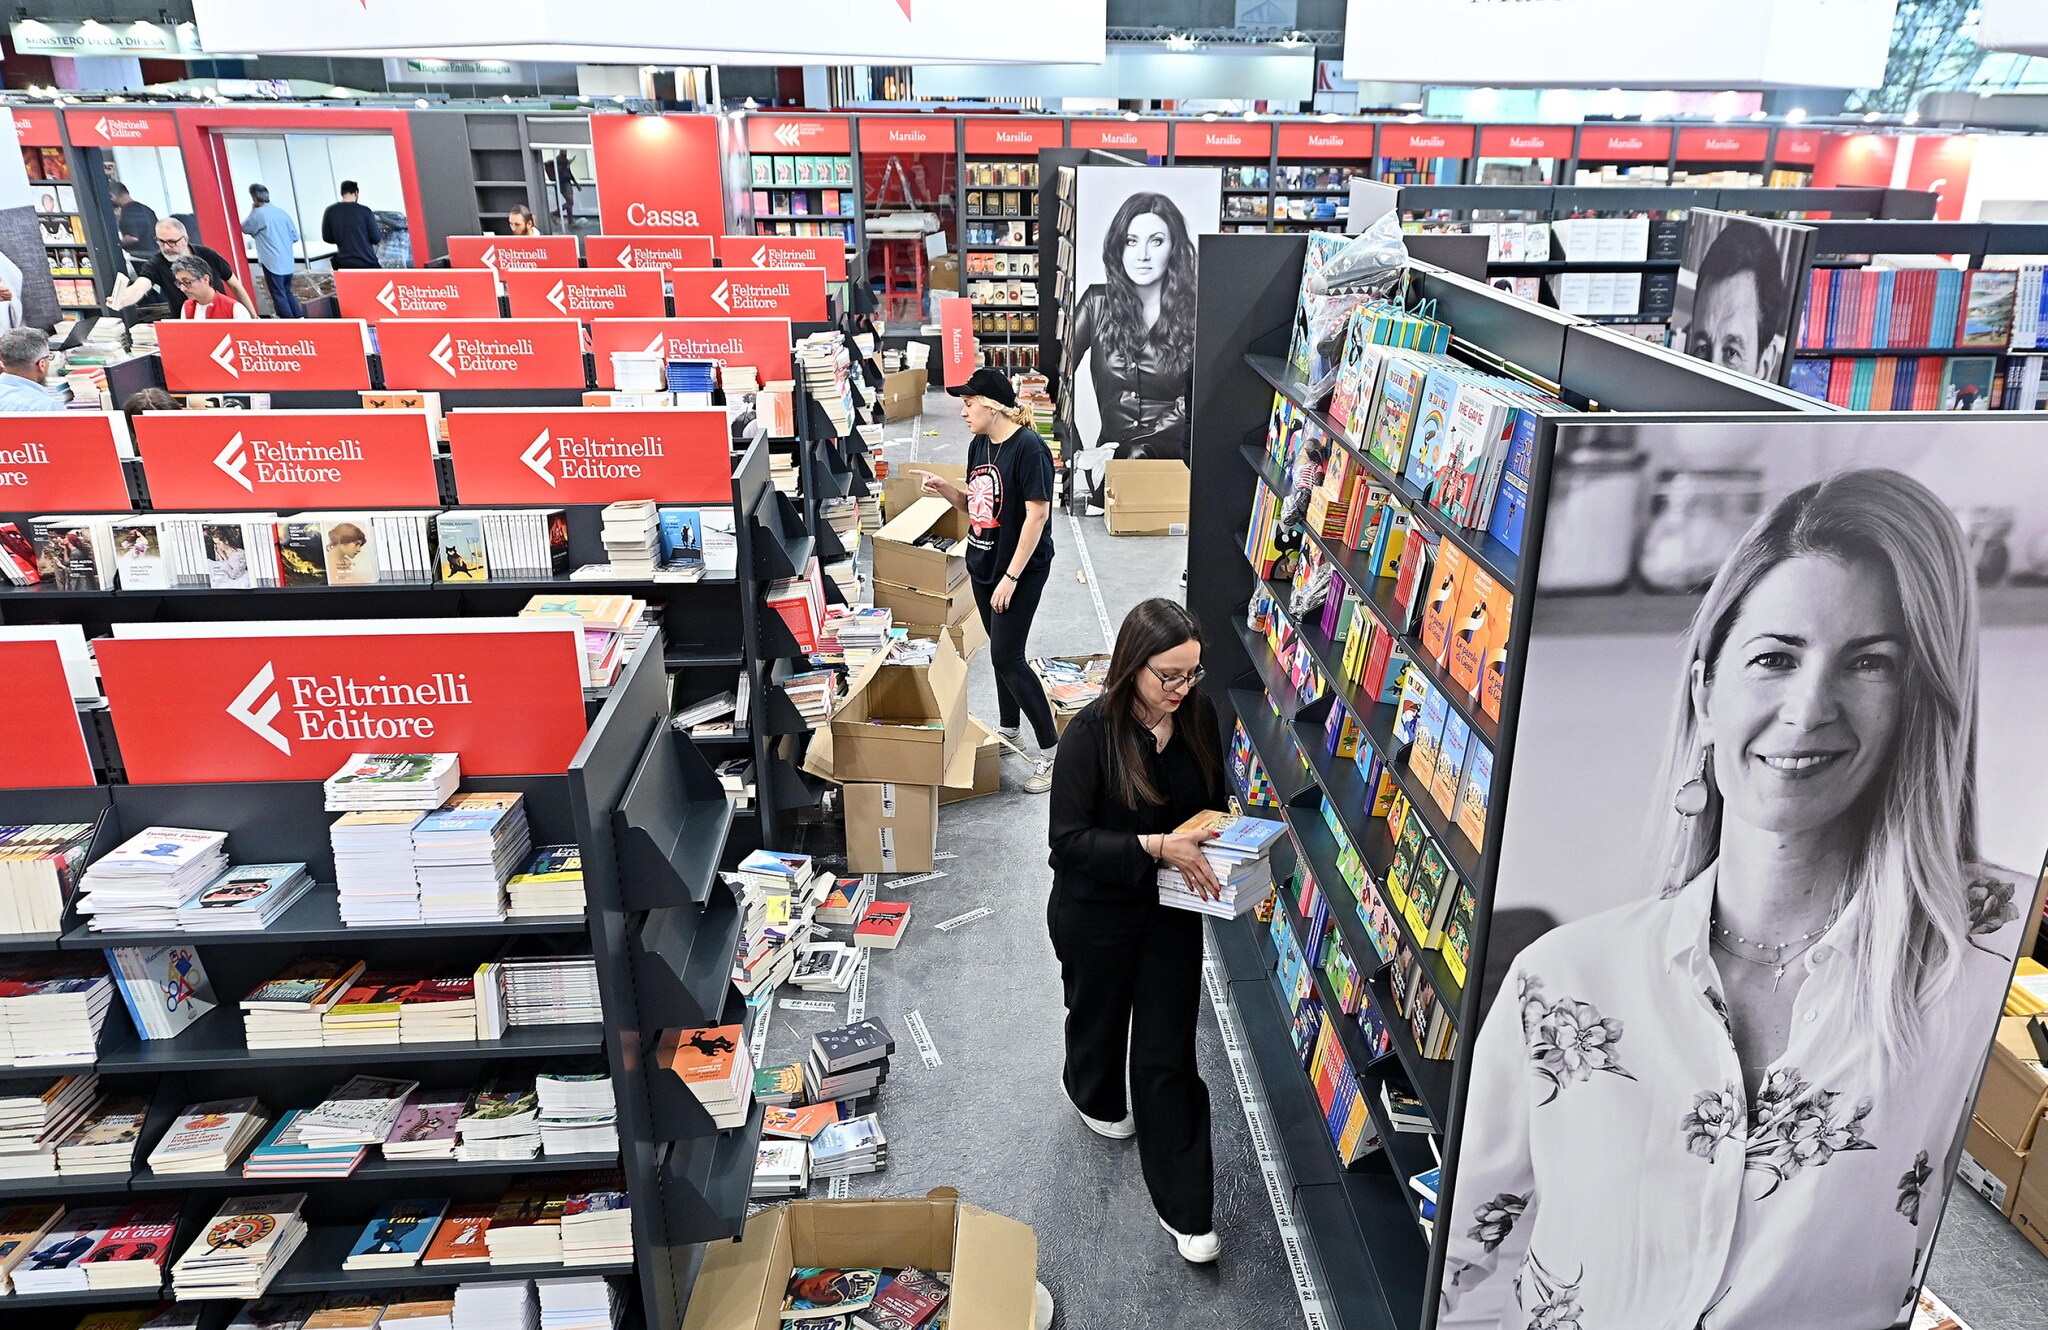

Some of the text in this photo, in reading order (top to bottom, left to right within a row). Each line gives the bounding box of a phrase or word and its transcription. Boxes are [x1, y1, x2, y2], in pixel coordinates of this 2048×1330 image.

[108, 119, 150, 130] Feltrinelli
[110, 128, 141, 138] Editore
[889, 129, 927, 142] Marsilio
[996, 131, 1033, 143] Marsilio
[1101, 132, 1138, 145] Marsilio
[1205, 134, 1241, 146] Marsilio
[1308, 135, 1344, 147] Marsilio
[1409, 136, 1445, 148] Marsilio
[1509, 137, 1545, 149] Marsilio
[1608, 137, 1643, 150] Marsilio
[1705, 138, 1740, 151] Marsilio
[627, 203, 699, 227] Cassa
[497, 248, 548, 260] Feltrinelli
[633, 248, 683, 260] Feltrinelli
[768, 248, 816, 260] Feltrinelli
[500, 259, 537, 269] Editore
[635, 259, 673, 269] Editore
[769, 259, 805, 268] Editore
[397, 284, 459, 299] Feltrinelli
[567, 284, 628, 298] Feltrinelli
[731, 283, 790, 296] Feltrinelli
[400, 298, 447, 311] Editore
[568, 297, 615, 310] Editore
[732, 296, 778, 309] Editore
[236, 340, 317, 356] Feltrinelli
[456, 339, 534, 355] Feltrinelli
[668, 338, 744, 354] Feltrinelli
[953, 327, 961, 364] Marsilio
[240, 356, 301, 372] Editore
[459, 355, 518, 371] Editore
[1457, 401, 1468, 417] THE
[1467, 409, 1485, 426] GAME
[250, 439, 364, 462] Feltrinelli
[556, 436, 665, 458] Feltrinelli
[255, 463, 341, 484] Editore
[560, 459, 642, 479] Editore
[1455, 637, 1462, 649] Le
[286, 673, 472, 708] Feltrinelli
[294, 710, 435, 741] Editore
[1233, 1057, 1250, 1095] ALLESTIMENTI
[1249, 1111, 1270, 1161] PP ALLESTIMENTI
[1266, 1170, 1290, 1227] PP ALLESTIMENTI
[110, 1228, 171, 1240] DI OGGI
[1286, 1237, 1313, 1301] PP ALLESTIMENTI
